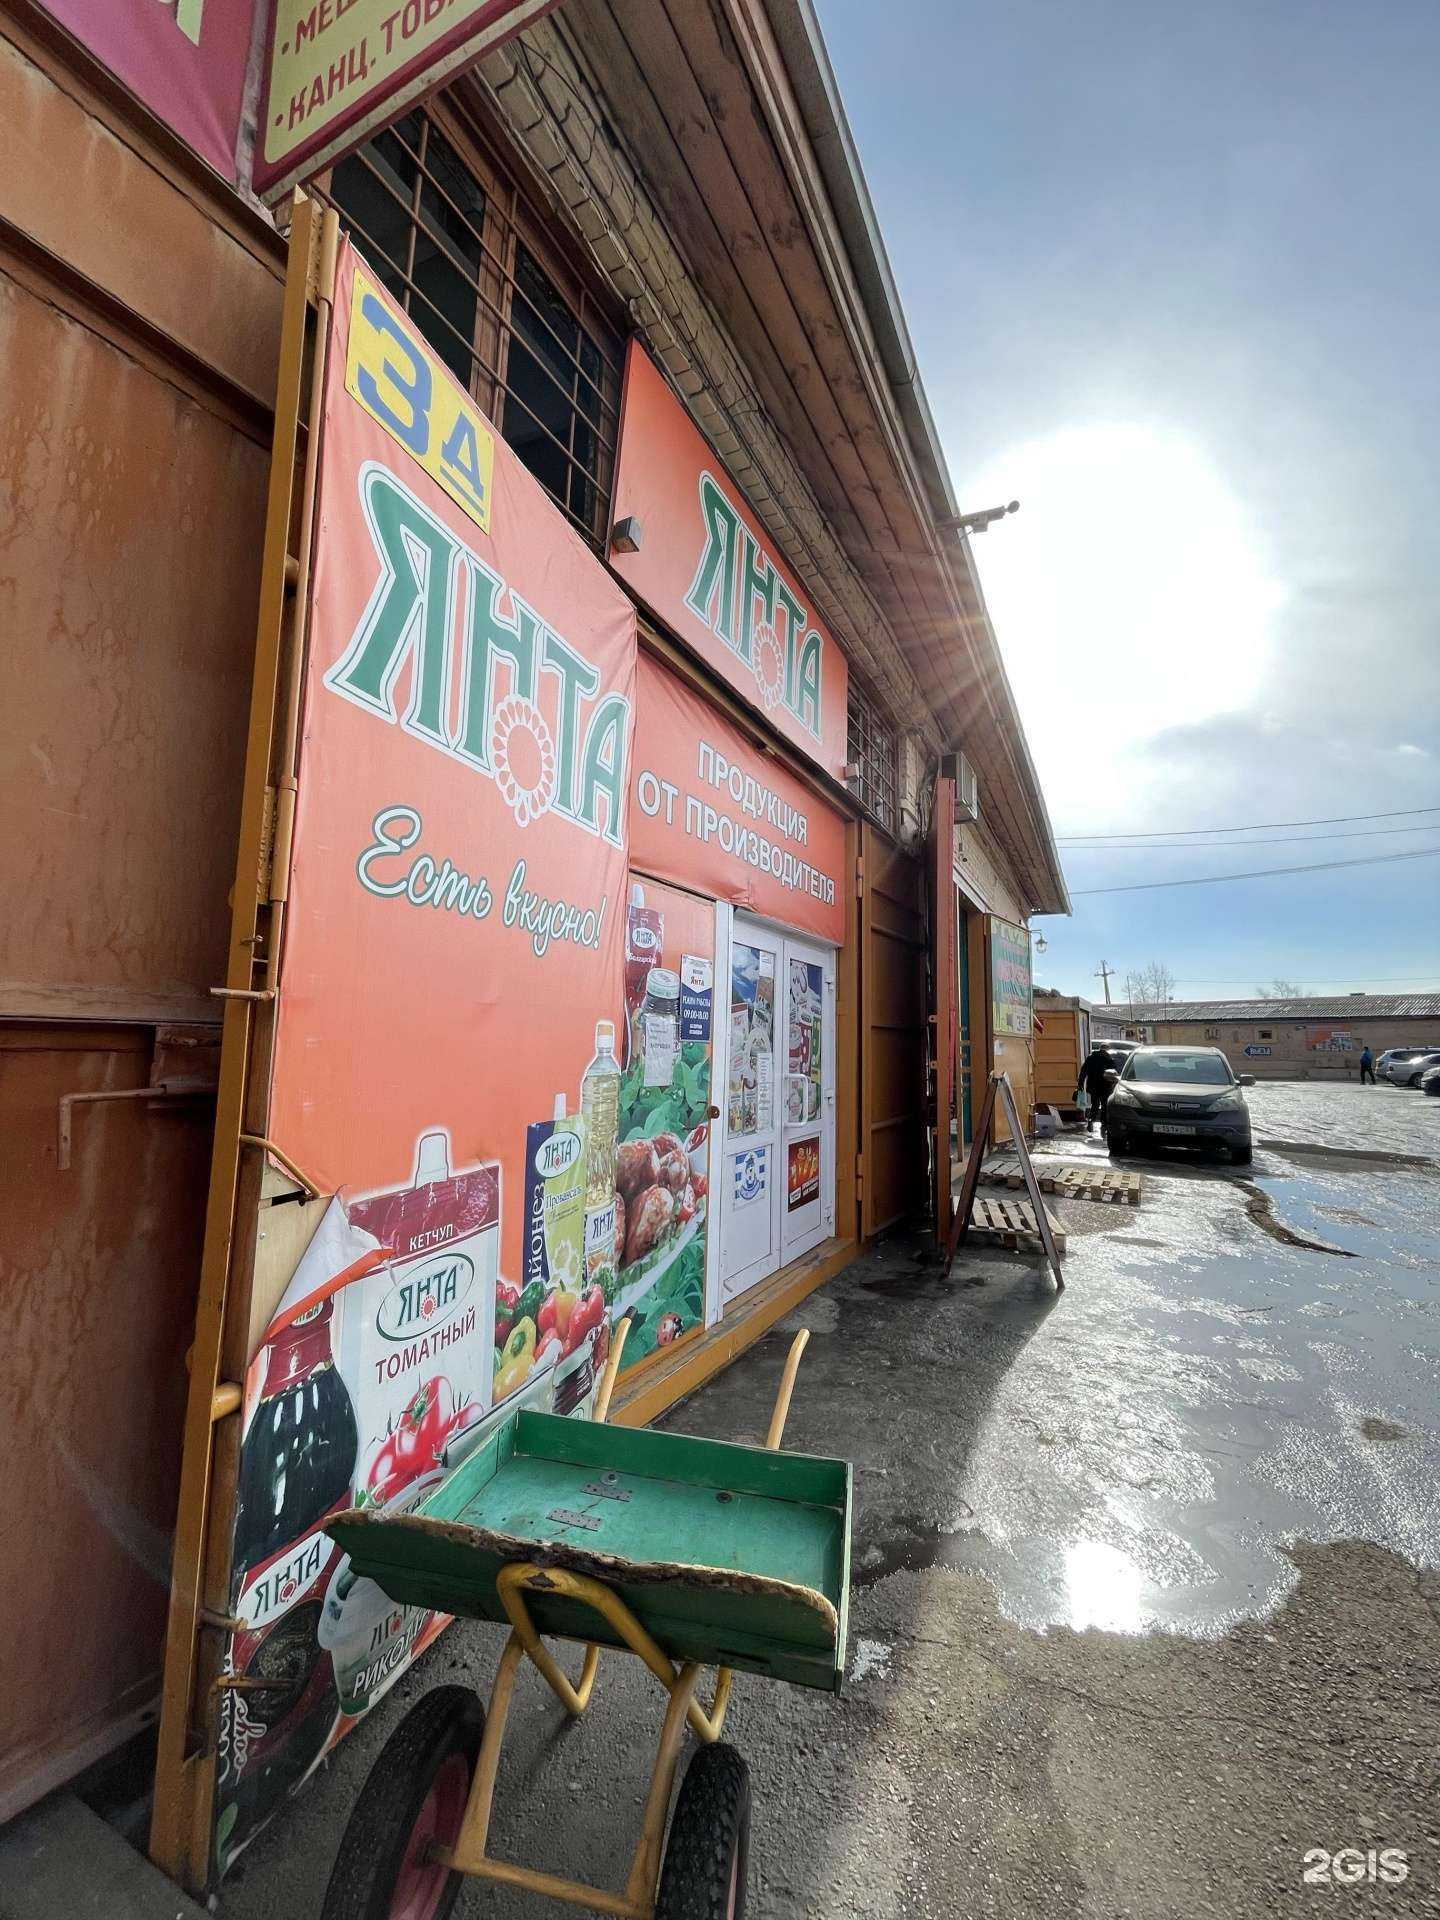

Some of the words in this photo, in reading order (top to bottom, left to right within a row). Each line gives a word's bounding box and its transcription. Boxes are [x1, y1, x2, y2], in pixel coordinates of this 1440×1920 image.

[295, 0, 360, 54] МЕ
[287, 37, 377, 131] КАНЦ.
[685, 470, 824, 746] ЯНТА
[323, 458, 632, 852] ЯНТА
[697, 740, 808, 846] ПРОДУКЦИЯ
[355, 804, 493, 922] Есть
[501, 857, 607, 958] вкусно!
[637, 769, 679, 825] ОТ
[685, 795, 836, 906] ПРОИЗВОДИТЕЛЯ
[543, 1137, 573, 1171] ЯНТА
[409, 1224, 454, 1252] КЕТЧУП
[397, 1262, 458, 1329] ЯНТА
[375, 1305, 476, 1385] ТОМАТНЫЙ
[253, 1537, 324, 1619] ЯНТА
